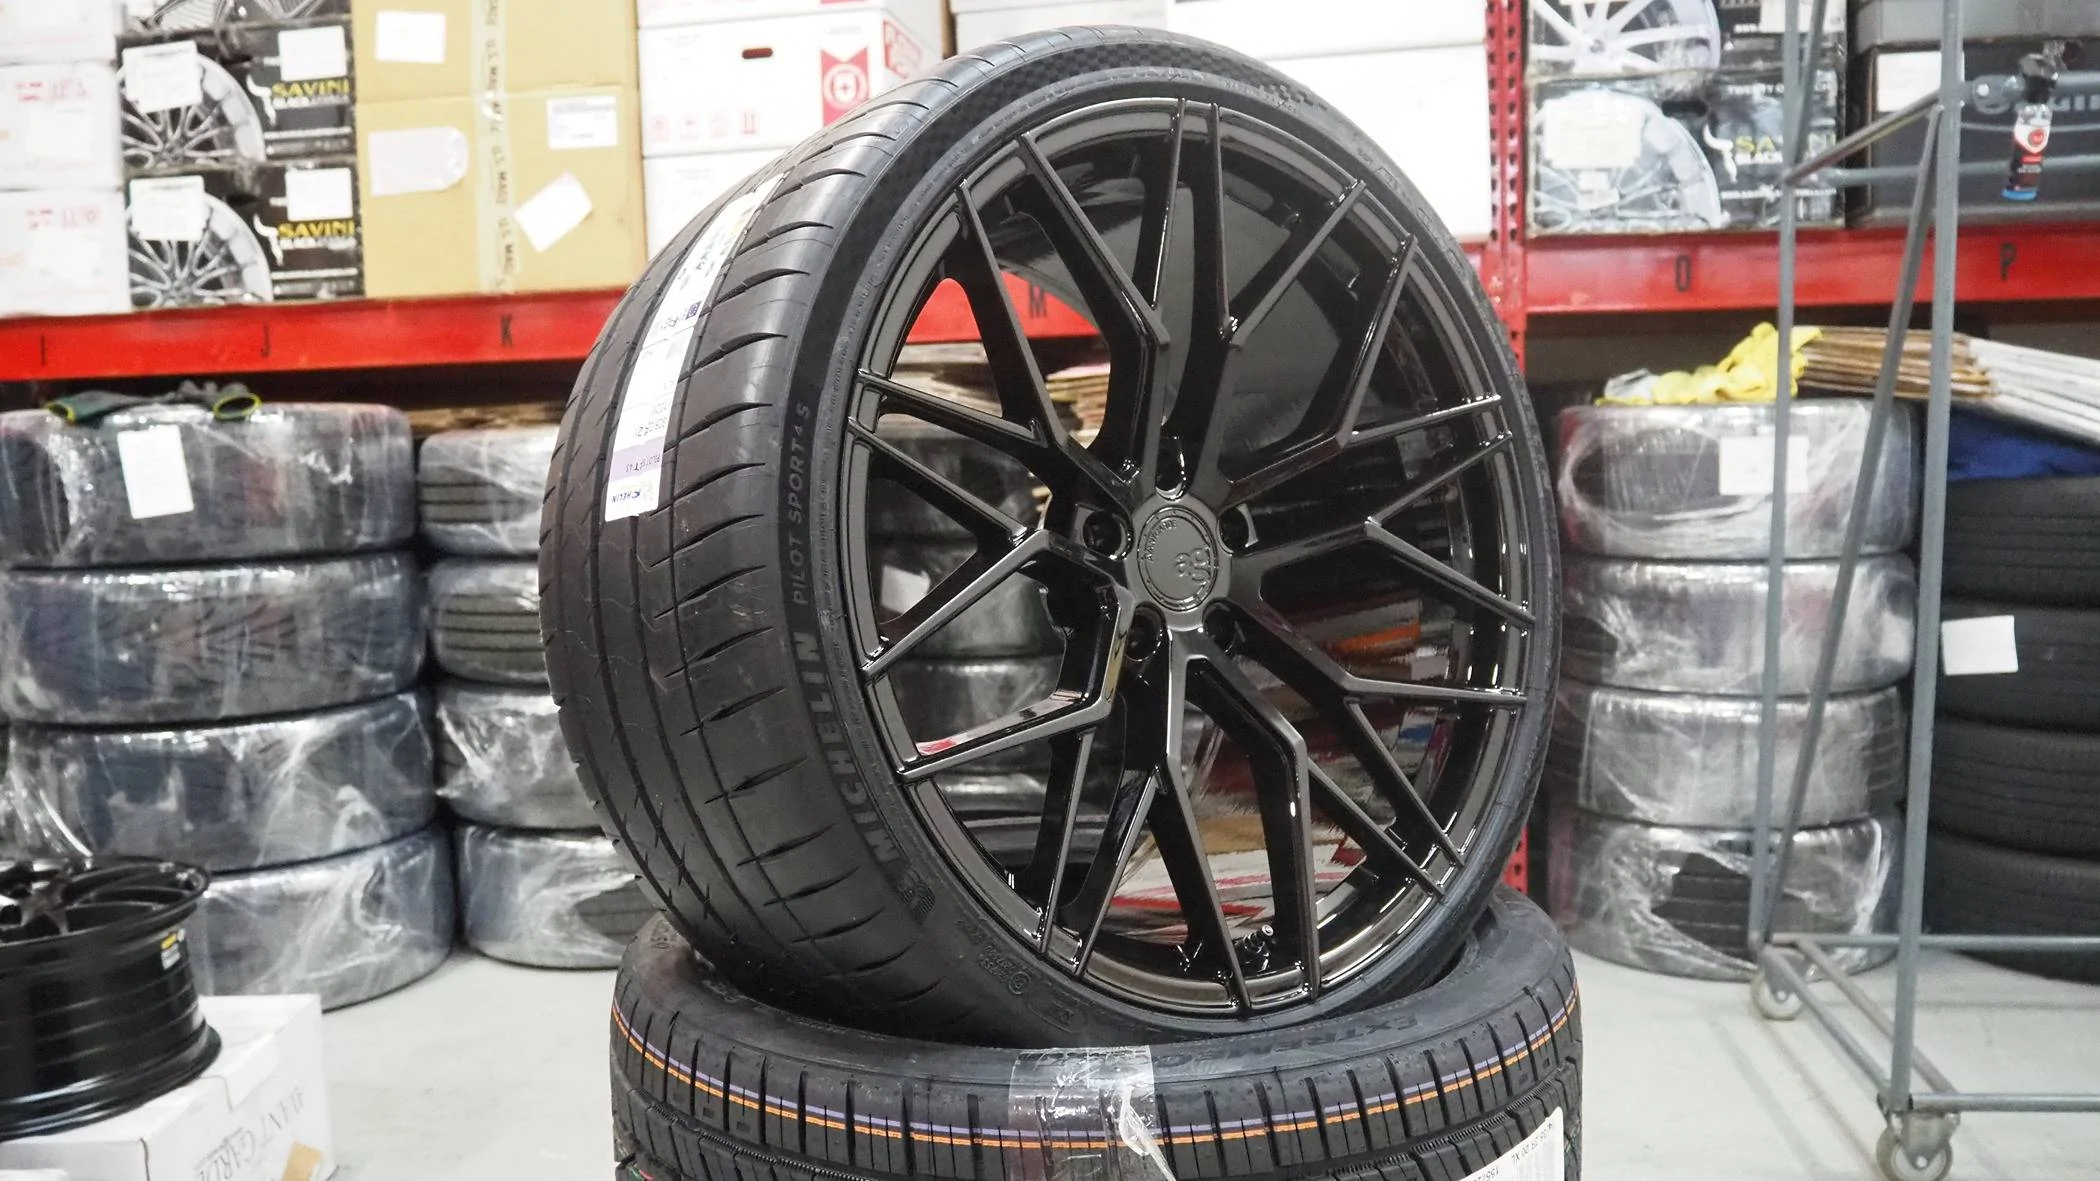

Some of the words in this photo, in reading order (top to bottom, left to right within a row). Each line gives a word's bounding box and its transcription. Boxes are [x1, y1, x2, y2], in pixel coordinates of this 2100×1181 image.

[271, 79, 349, 97] SAVINI
[1735, 132, 1837, 155] SANI
[278, 221, 356, 239] SAVINI
[2001, 243, 2017, 281] P
[261, 323, 271, 358] J
[501, 314, 514, 348] K
[788, 440, 806, 525] SPORT
[789, 536, 809, 606] PILOT
[793, 631, 899, 863] MICHELIN
